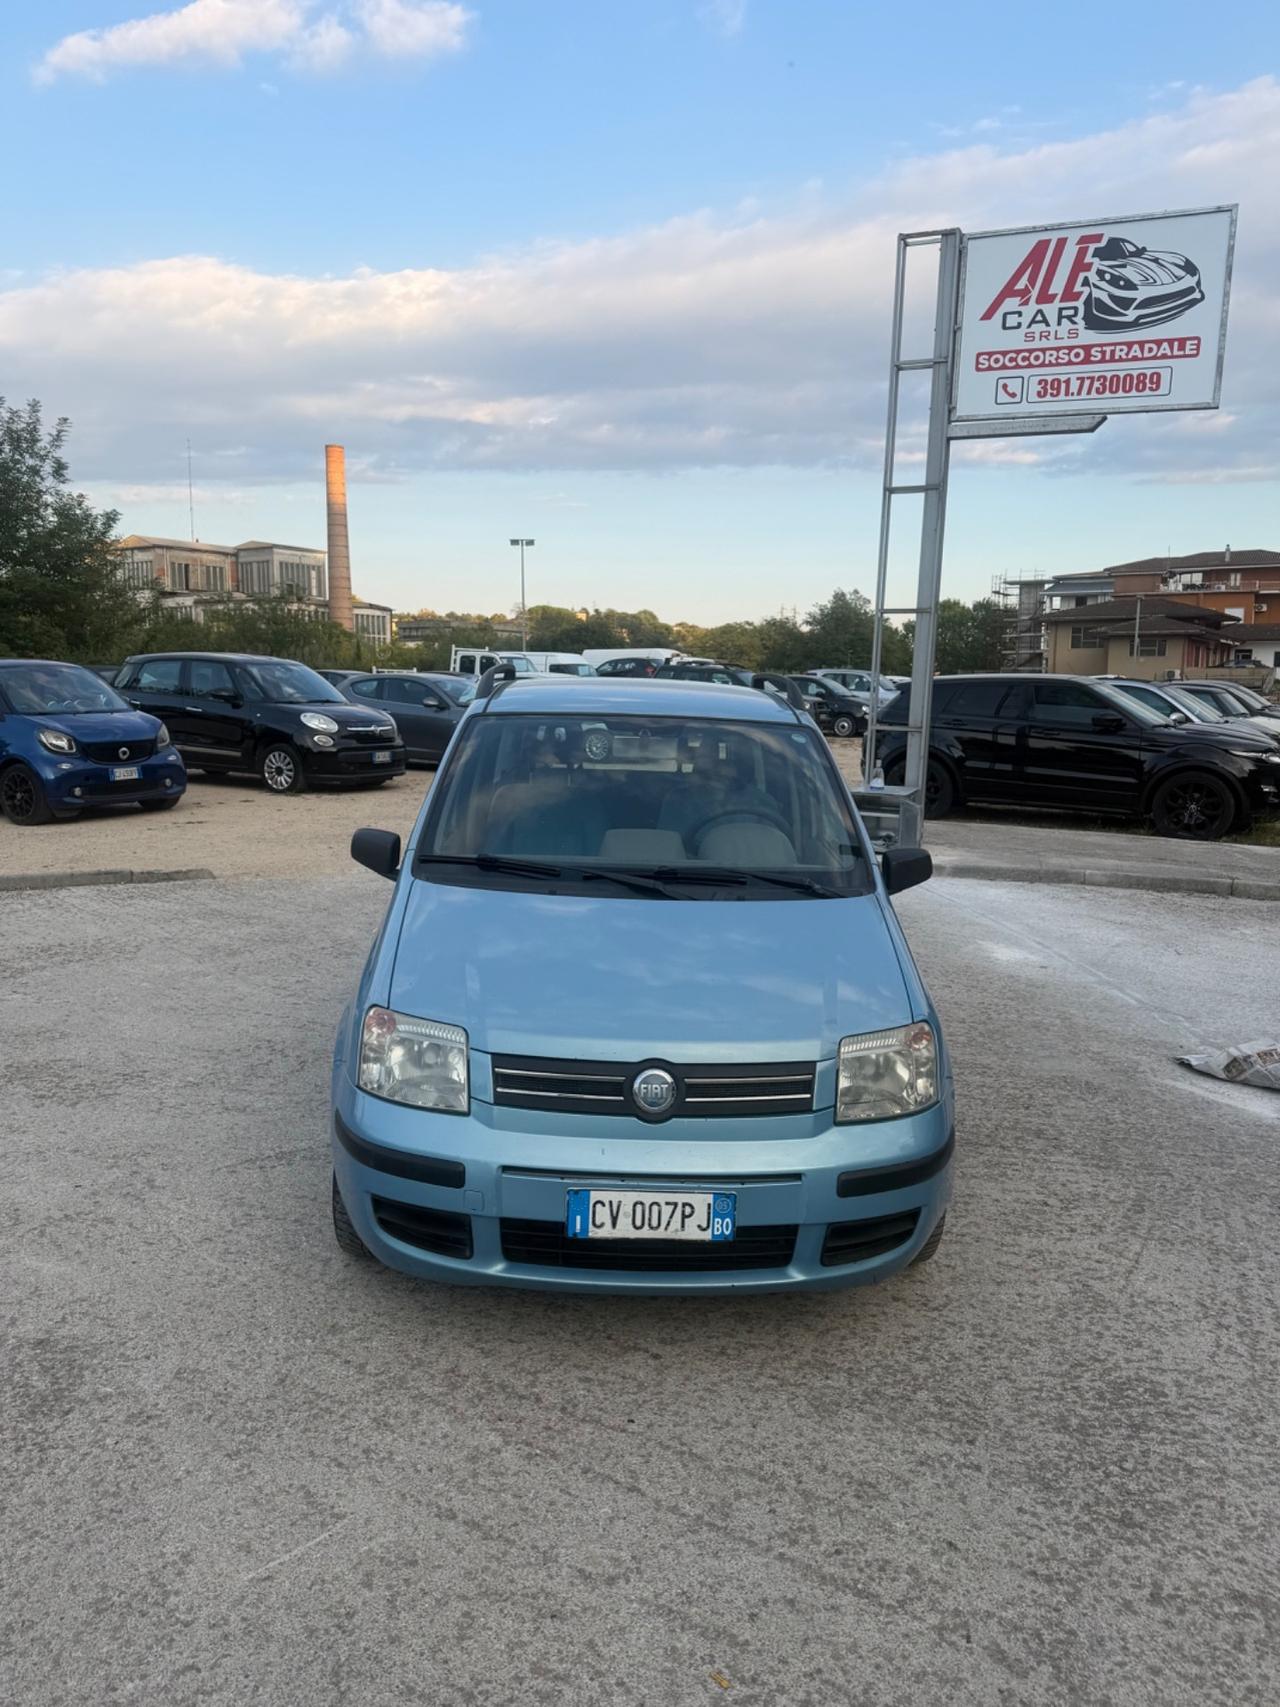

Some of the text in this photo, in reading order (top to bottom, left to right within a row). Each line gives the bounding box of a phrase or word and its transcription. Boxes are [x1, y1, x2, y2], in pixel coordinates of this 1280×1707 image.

[979, 233, 1104, 321] ALE
[1001, 305, 1079, 331] CAR
[1023, 328, 1079, 343] SRLS
[977, 339, 1198, 370] SOCCORSO STRADALE
[1036, 371, 1162, 399] 391.7730089
[639, 1083, 669, 1099] FIAT
[591, 1199, 622, 1230] CV
[631, 1201, 711, 1232] 007PJ
[713, 1217, 732, 1236] BO
